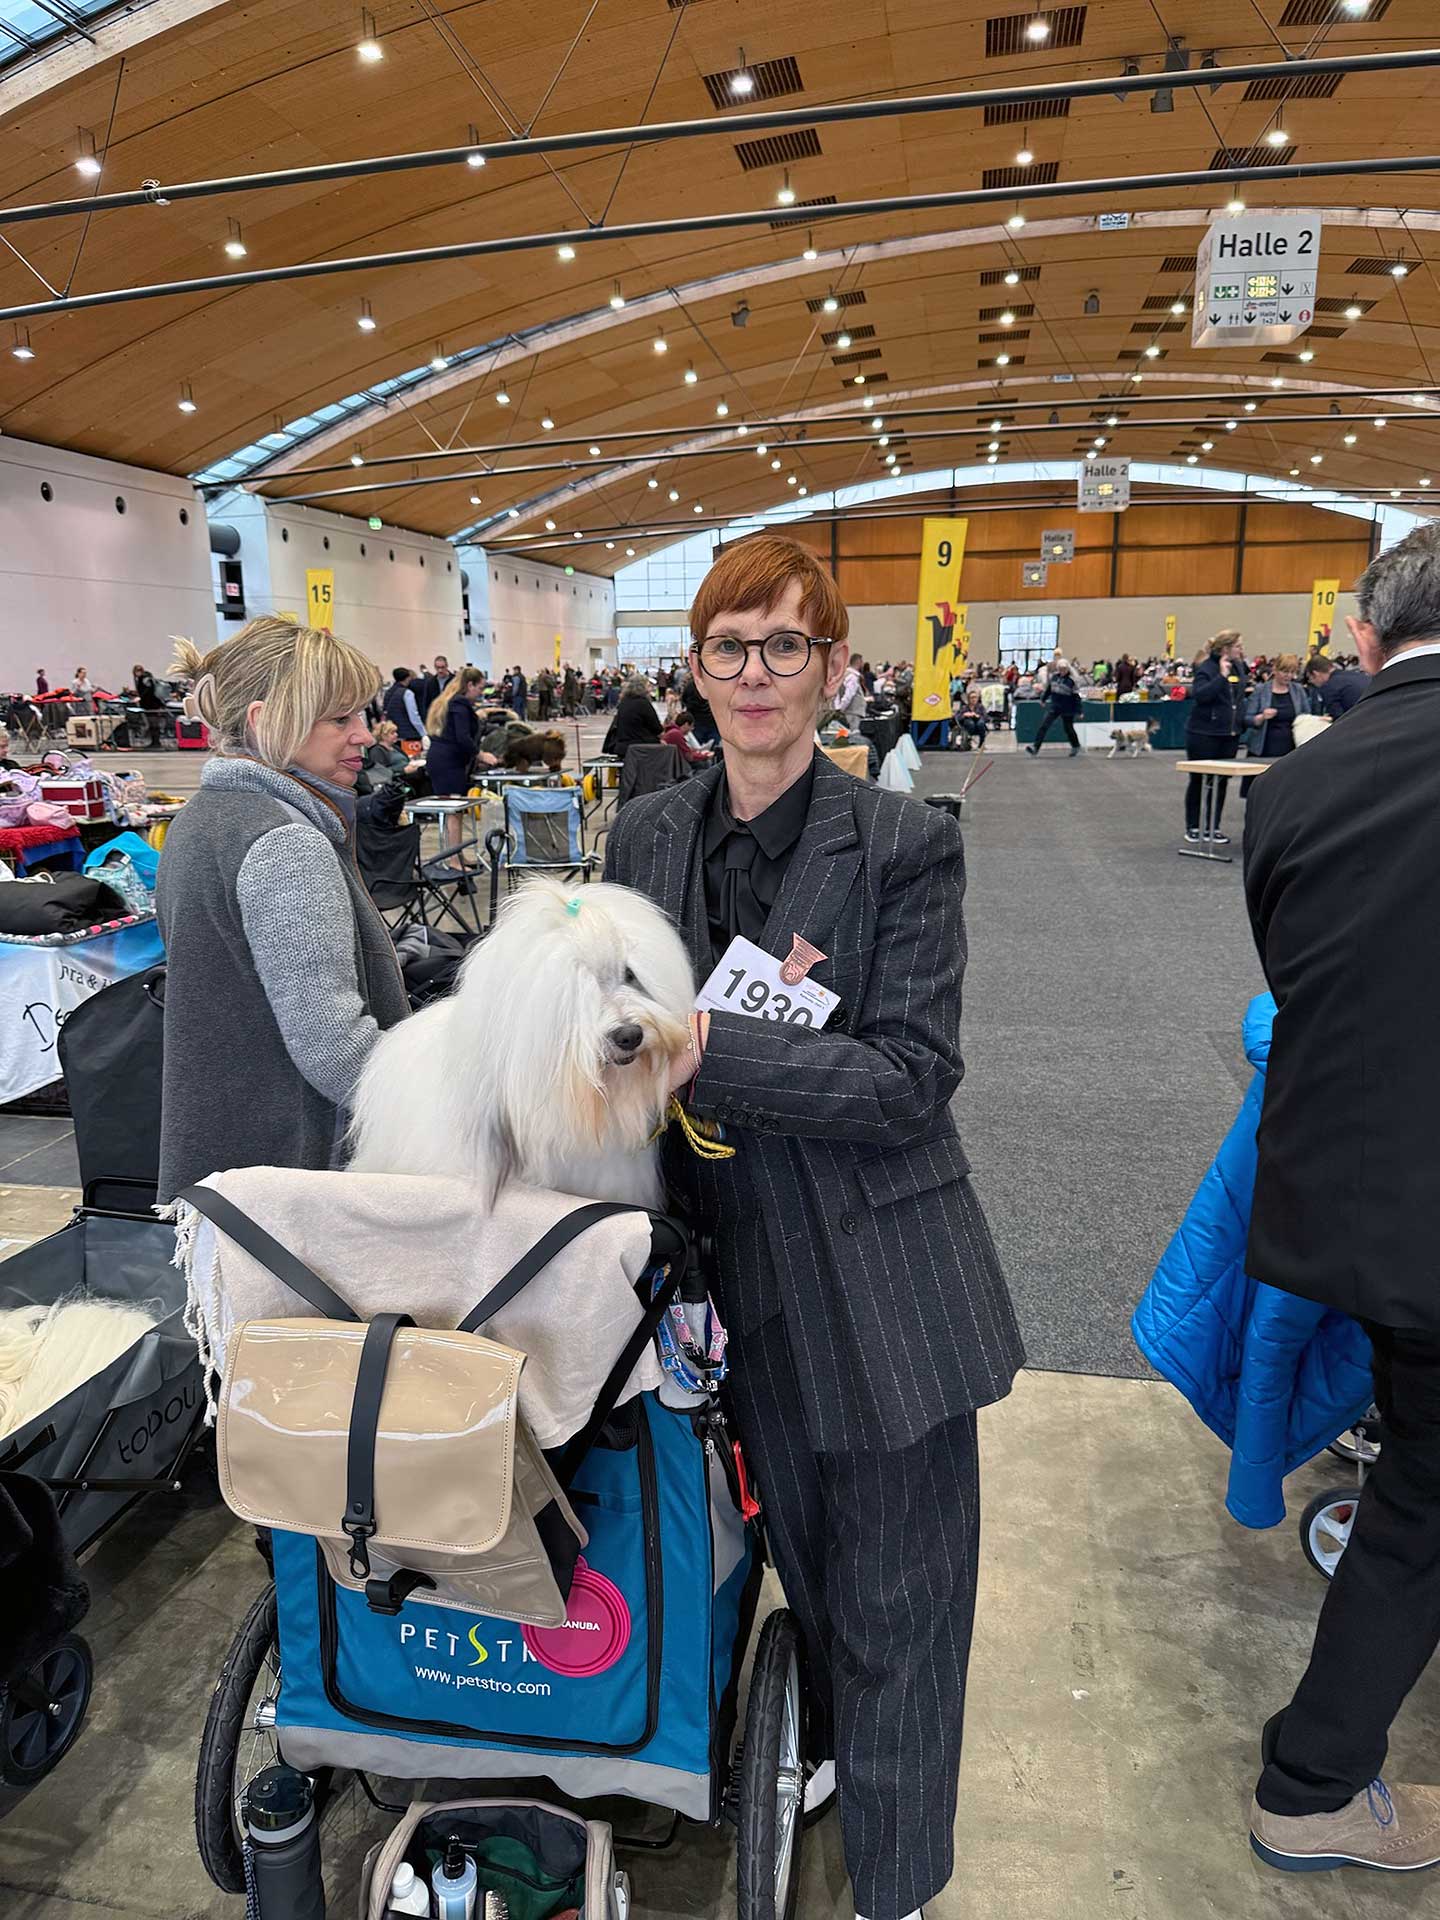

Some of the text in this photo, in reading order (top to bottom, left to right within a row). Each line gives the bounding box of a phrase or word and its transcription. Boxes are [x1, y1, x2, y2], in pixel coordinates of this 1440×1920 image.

[1219, 230, 1313, 258] Halle 2
[1085, 464, 1128, 477] Halle 2
[937, 540, 952, 567] 9
[312, 584, 331, 603] 15
[1316, 591, 1335, 606] 10
[561, 1620, 601, 1631] ANUBA
[414, 1665, 551, 1696] www.petstro.com
